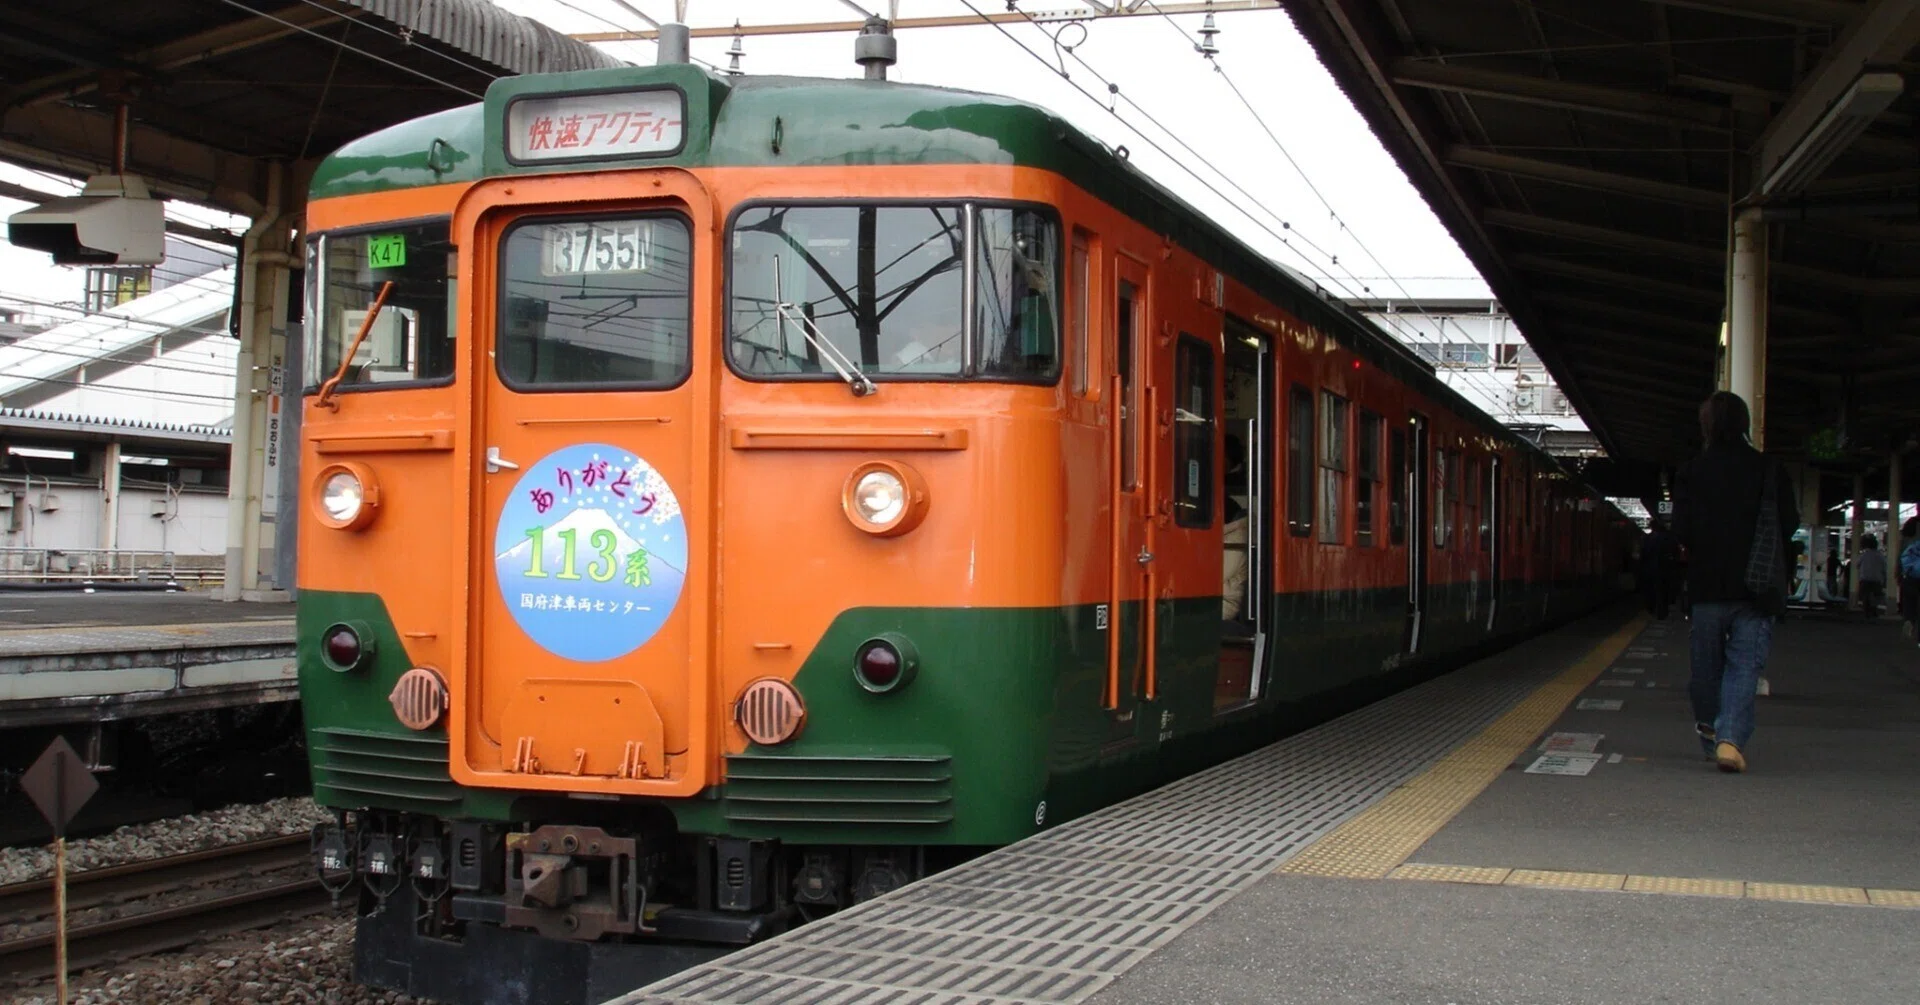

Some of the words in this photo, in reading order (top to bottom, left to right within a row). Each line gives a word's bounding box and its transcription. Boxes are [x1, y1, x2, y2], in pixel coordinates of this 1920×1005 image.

[528, 111, 681, 150] 快速アクティー
[370, 241, 402, 264] K47
[529, 460, 657, 515] ありがとう
[523, 525, 652, 588] 113系
[520, 593, 651, 615] 国府津車両センター
